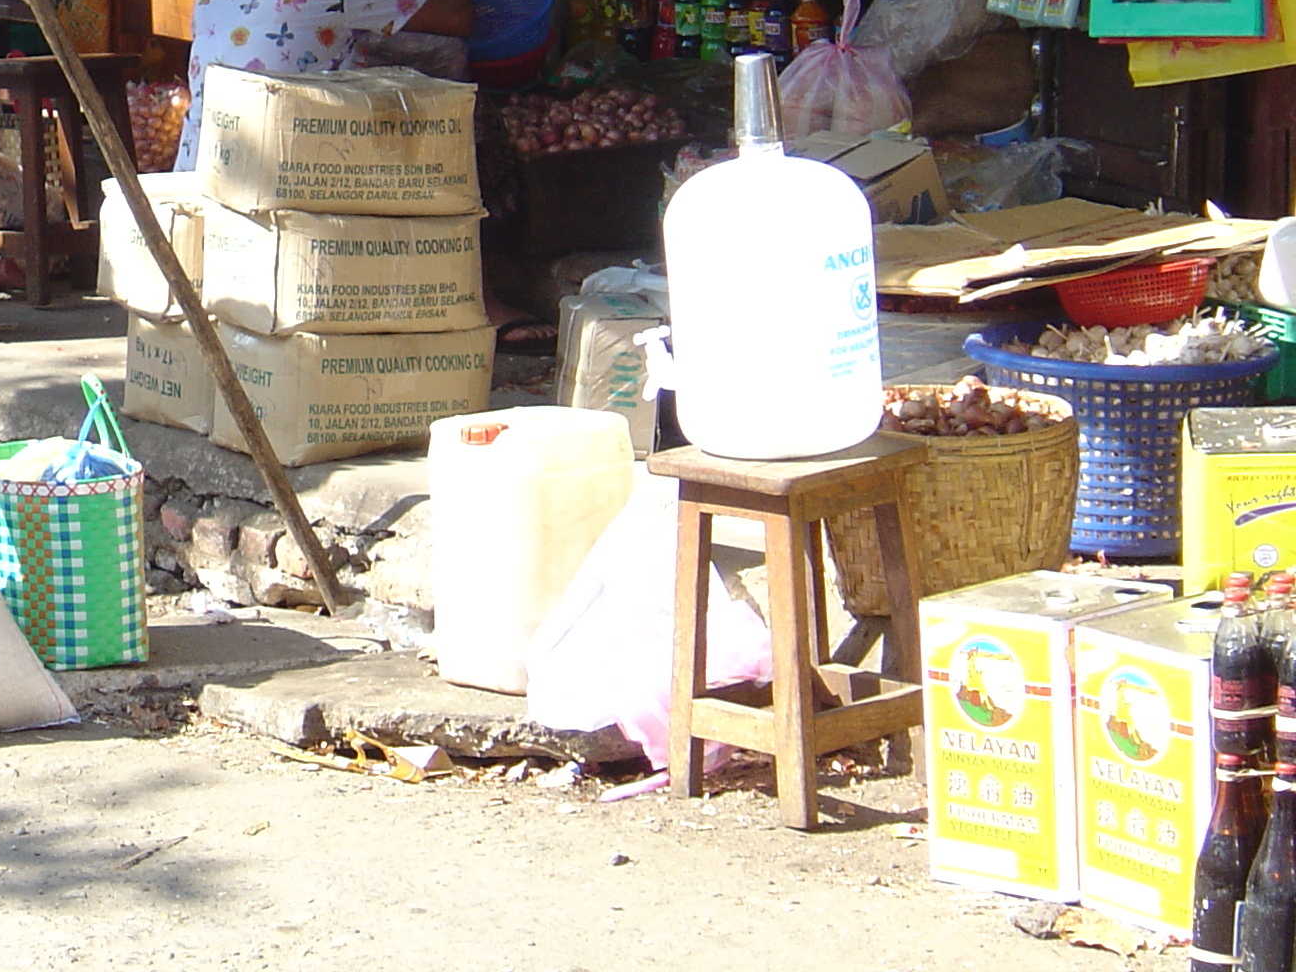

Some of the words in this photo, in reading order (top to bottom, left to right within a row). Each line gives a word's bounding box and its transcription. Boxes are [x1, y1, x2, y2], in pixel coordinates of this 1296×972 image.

[294, 118, 346, 134] PREMIUM
[350, 119, 395, 136] QUALITY
[400, 119, 445, 136] COOKING
[448, 119, 461, 133] OIL
[279, 162, 310, 174] KIARA
[314, 164, 341, 175] FOOD
[344, 165, 401, 175] INDUSTRIES
[295, 176, 327, 187] JALAN
[331, 177, 352, 188] 2/12,
[355, 177, 396, 188] BANDAR
[399, 177, 424, 188] BARU
[427, 174, 467, 187] SELAYANG
[310, 190, 364, 200] SELANGOR
[367, 190, 398, 200] DARUL
[311, 239, 363, 256] PREMIUM
[367, 240, 409, 256] QUALITY
[416, 238, 461, 255] COOKING
[464, 237, 473, 251] OIL
[297, 284, 329, 295] KIARA
[332, 284, 359, 295] FOOD
[362, 284, 416, 295] INDUSTRIES
[315, 298, 346, 309] JALAN
[373, 298, 410, 309] BANDAR
[414, 296, 438, 307] BARU
[329, 311, 381, 322] SELANGOR
[384, 310, 412, 320] DARUL
[136, 337, 145, 357] kg
[148, 345, 151, 359] 1
[155, 347, 160, 358] x
[162, 350, 172, 366] 17
[322, 359, 373, 374] PREMIUM
[377, 357, 421, 373] QUALITY
[426, 355, 472, 371] COOKING
[474, 354, 485, 368] OIL
[129, 369, 158, 393] WEIGHT
[161, 380, 181, 399] NET
[309, 403, 341, 415] KIARA
[344, 403, 370, 414] FOOD
[374, 401, 427, 414] INDUSTRIES
[309, 419, 322, 431] 10,
[326, 418, 357, 430] JALAN
[362, 417, 381, 429] 2/12,
[385, 416, 423, 428] BANDAR
[341, 430, 394, 442] SELANGOR
[1226, 492, 1258, 514] Your
[944, 730, 1036, 760] NELAYAN
[943, 751, 987, 767] MINYAK
[993, 760, 1036, 775] MASAK
[1096, 760, 1179, 799] NELAYAN
[951, 821, 1011, 841] VEGETABLE
[1019, 833, 1036, 845] OIL
